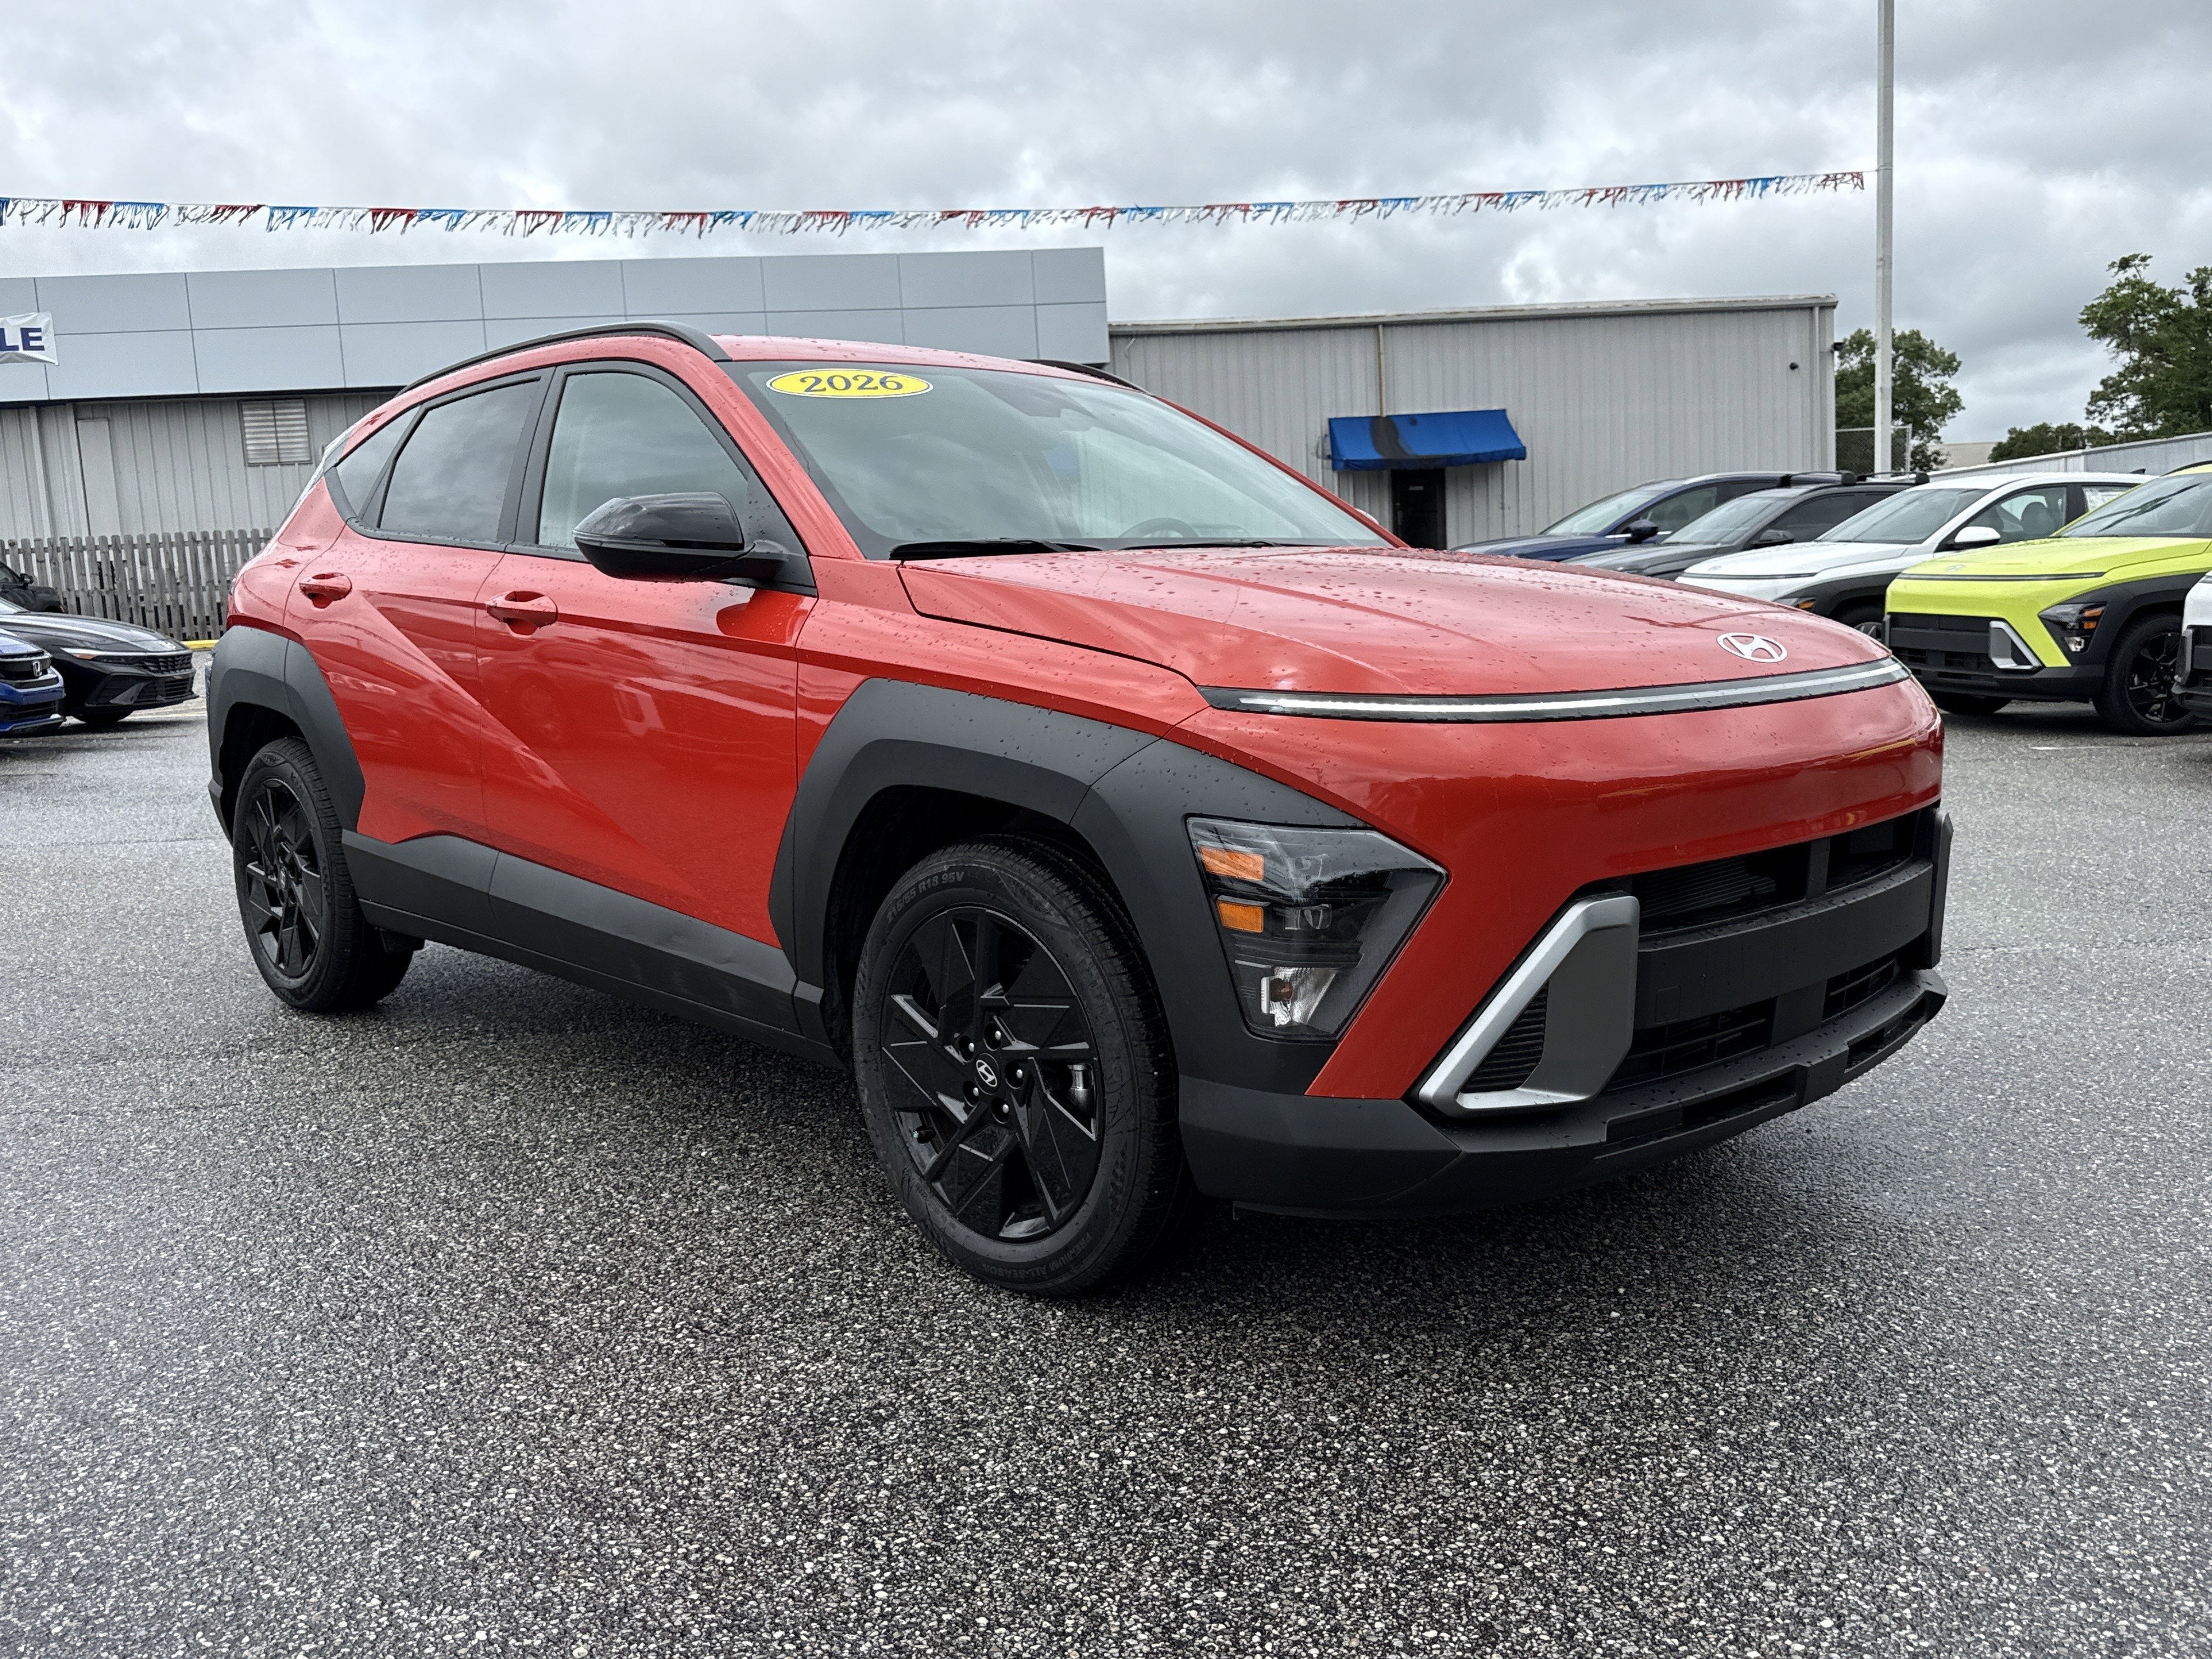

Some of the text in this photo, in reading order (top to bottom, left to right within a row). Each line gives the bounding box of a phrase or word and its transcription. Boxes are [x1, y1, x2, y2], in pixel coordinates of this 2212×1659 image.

[799, 374, 904, 393] 2026
[886, 871, 965, 923] 215/55 R18 95V
